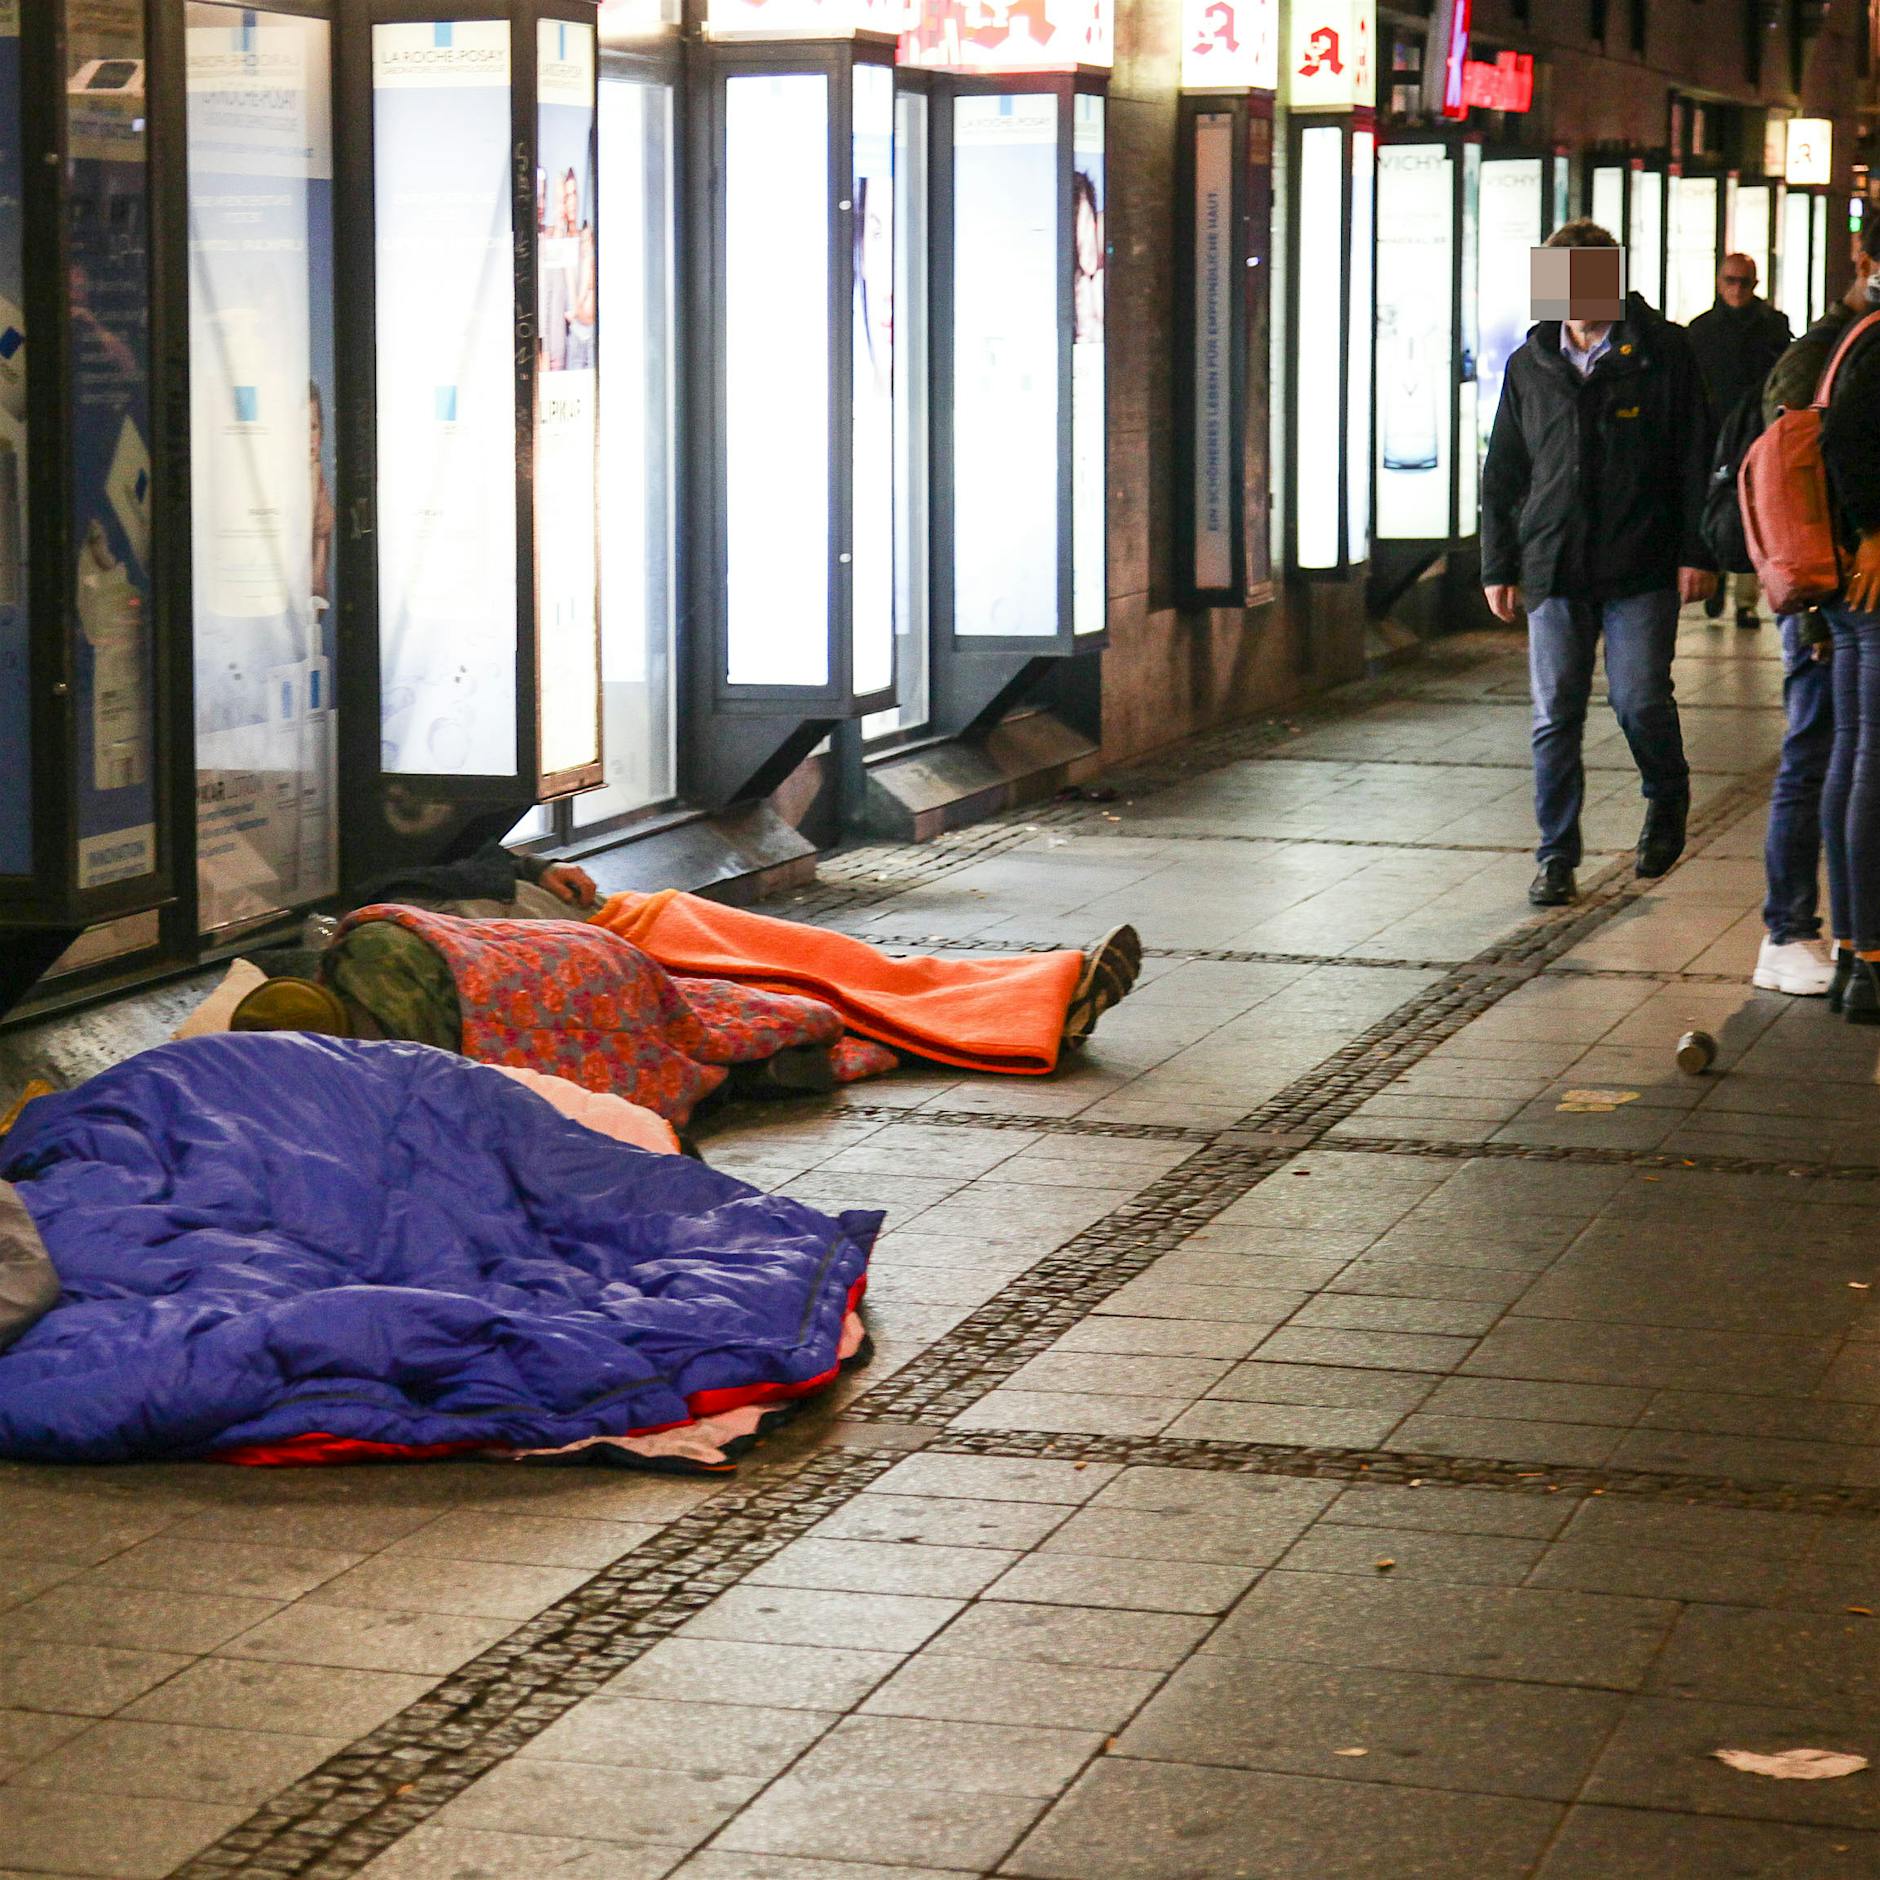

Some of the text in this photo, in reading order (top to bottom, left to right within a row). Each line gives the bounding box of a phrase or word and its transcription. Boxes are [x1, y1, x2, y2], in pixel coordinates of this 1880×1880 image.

[382, 49, 505, 65] LA ROCHE-POSAY
[1379, 154, 1444, 171] VICHY
